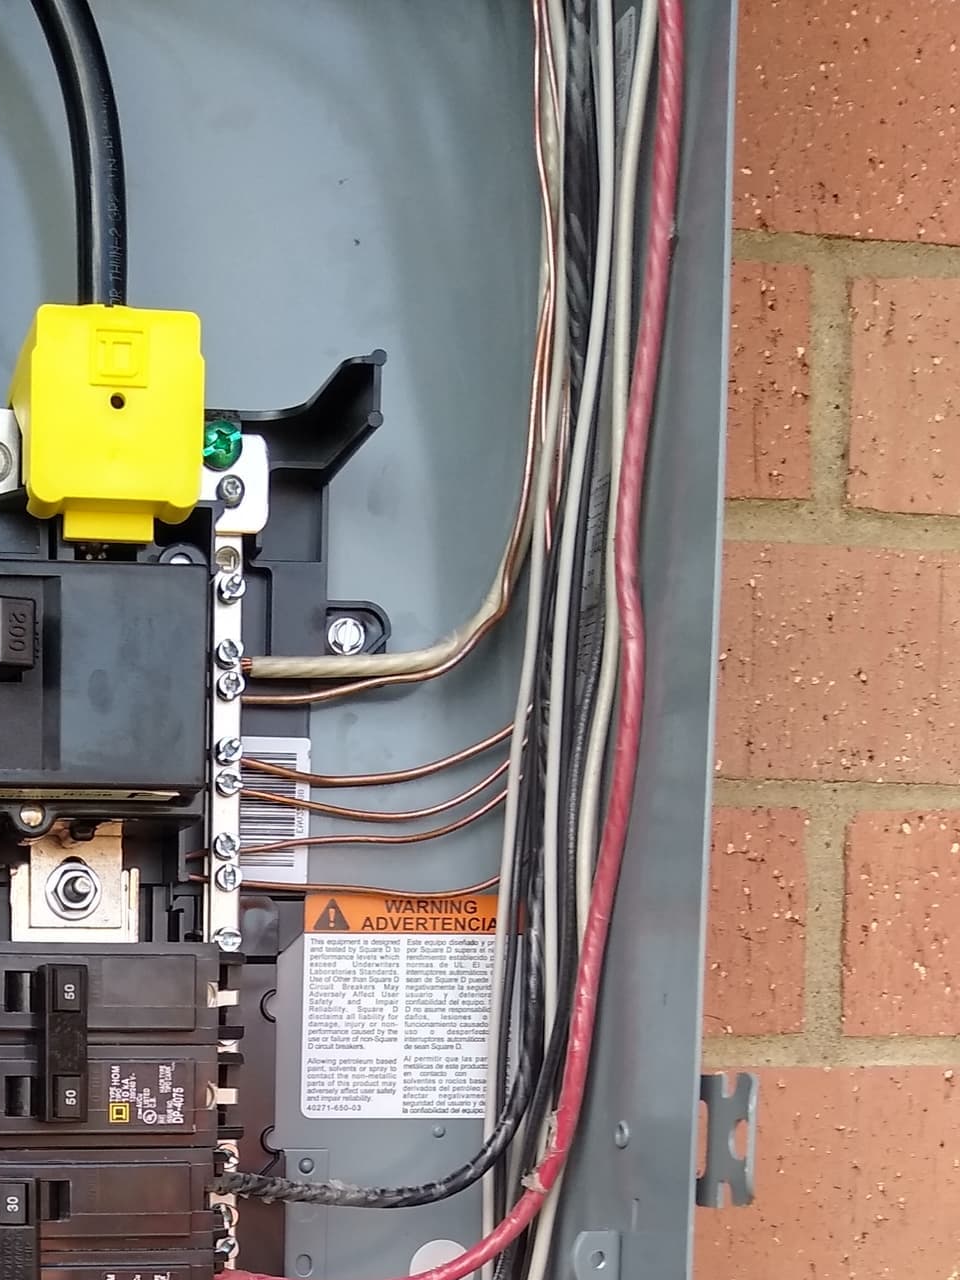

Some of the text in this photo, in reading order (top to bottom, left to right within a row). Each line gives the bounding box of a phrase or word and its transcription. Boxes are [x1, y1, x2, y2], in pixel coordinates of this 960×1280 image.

[8, 612, 27, 652] 200
[384, 899, 478, 914] WARNING
[361, 916, 497, 932] ADVERTENCIA
[64, 984, 75, 999] 50
[112, 1066, 120, 1085] HOM
[65, 1090, 76, 1105] 50
[173, 1088, 184, 1123] DP-4075
[7, 1196, 19, 1212] 30
